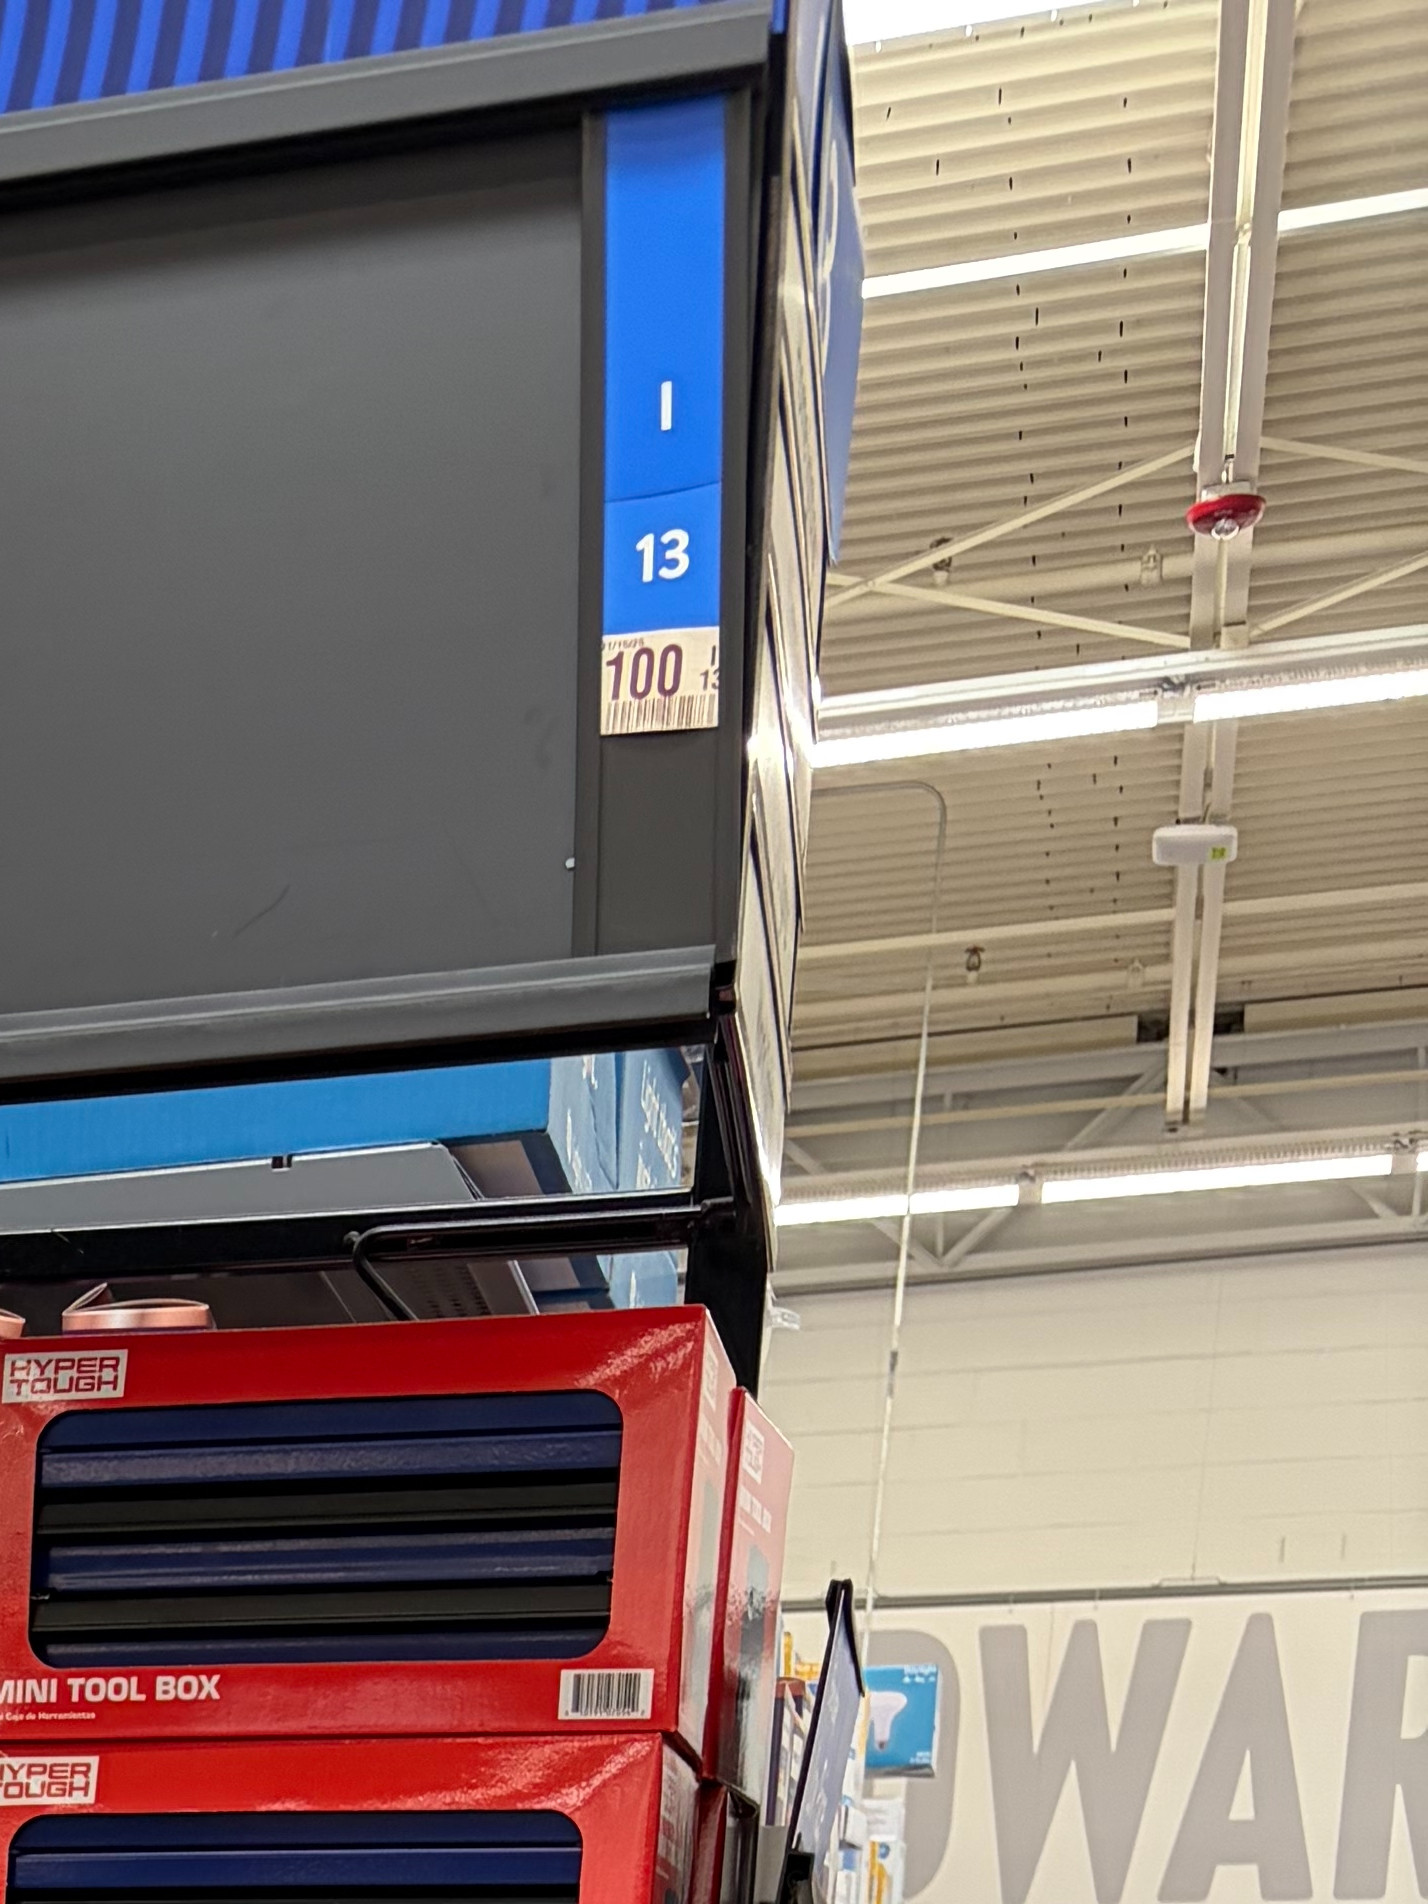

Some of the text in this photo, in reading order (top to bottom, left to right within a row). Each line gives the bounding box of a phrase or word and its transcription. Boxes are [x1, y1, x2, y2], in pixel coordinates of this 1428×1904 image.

[635, 528, 690, 583] 13
[606, 643, 684, 700] 100
[11, 1355, 122, 1379] HYPER
[9, 1373, 120, 1398] TOUGH
[67, 1676, 146, 1703] TOOL
[156, 1675, 220, 1701] BOX
